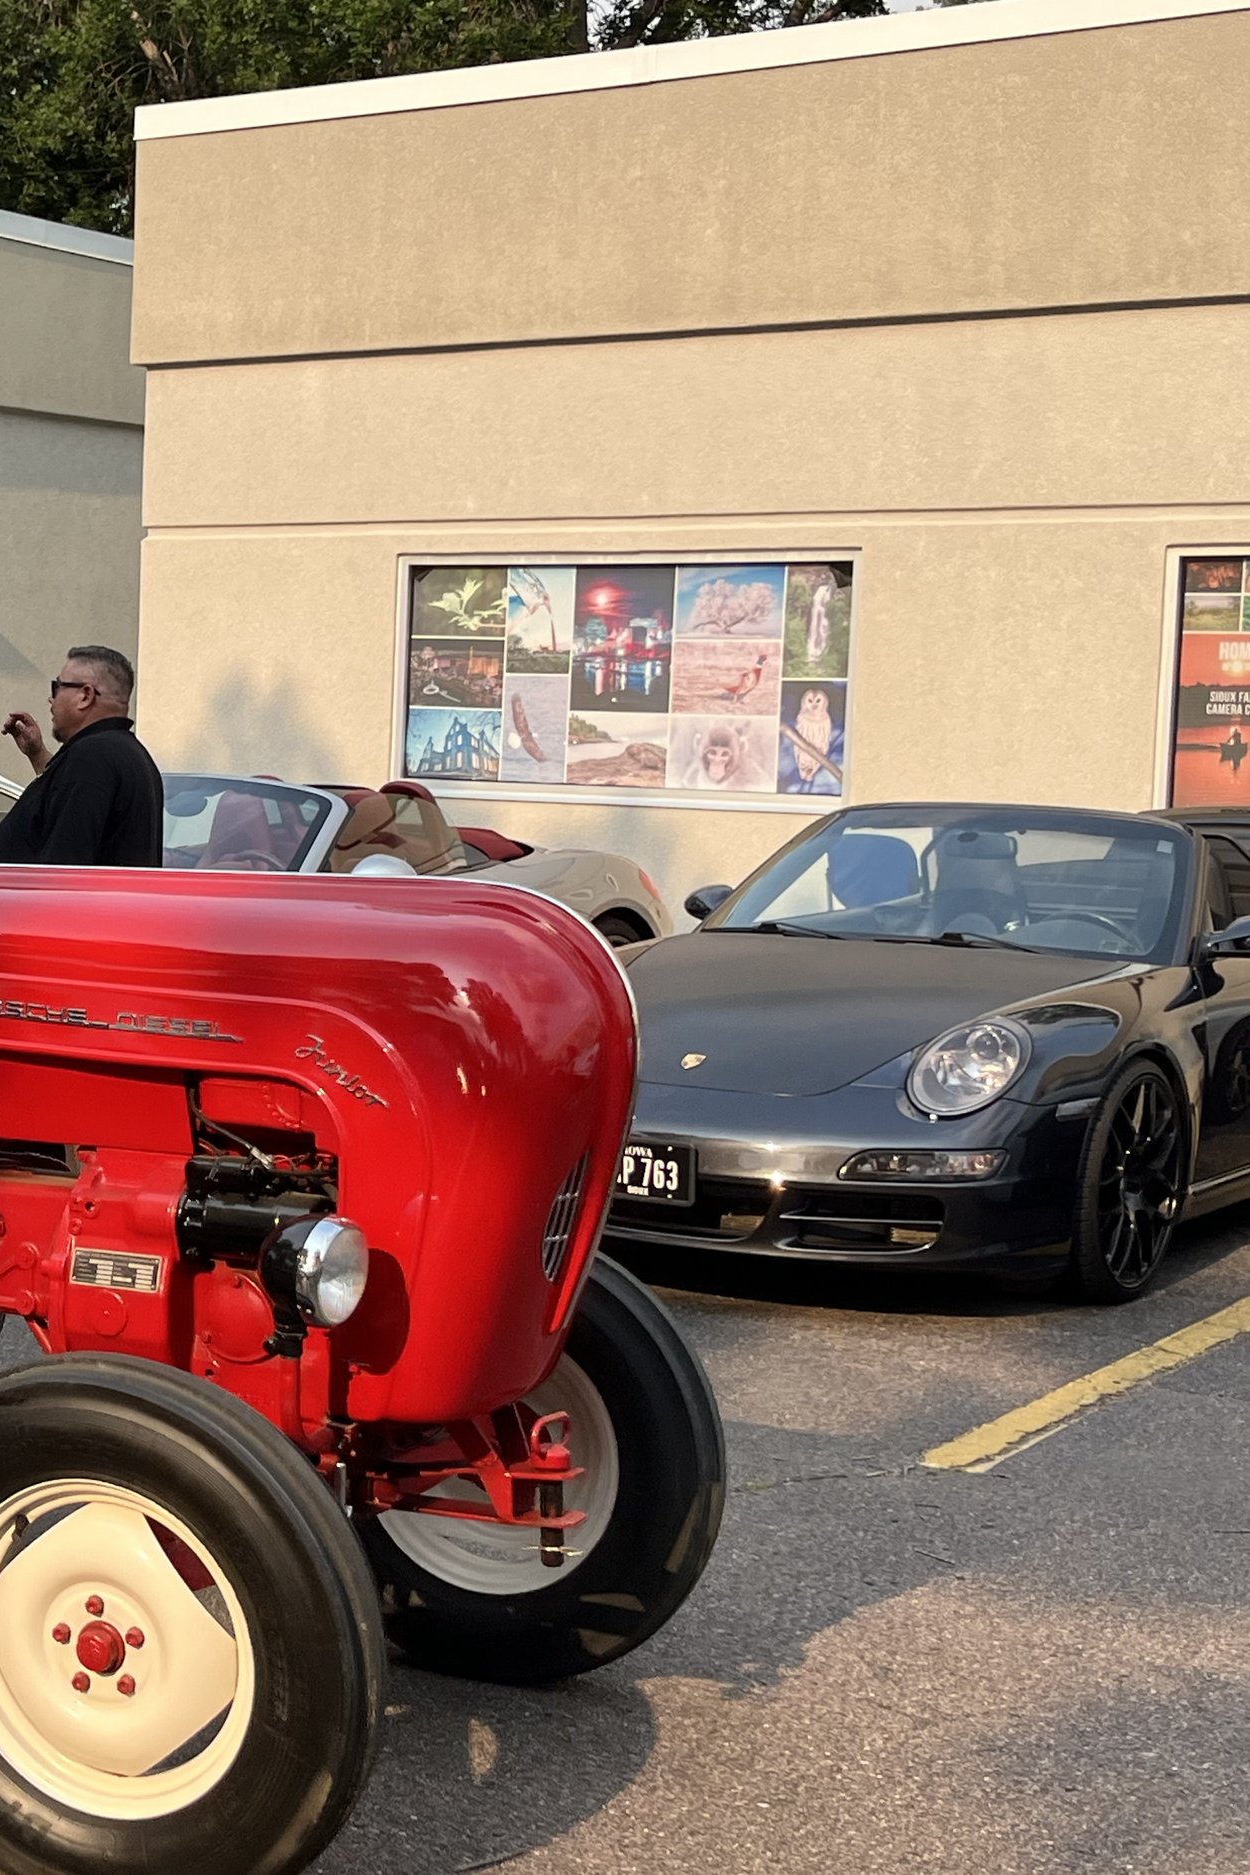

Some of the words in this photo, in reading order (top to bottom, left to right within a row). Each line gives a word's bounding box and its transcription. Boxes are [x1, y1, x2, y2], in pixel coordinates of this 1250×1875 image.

[1210, 691, 1237, 702] SIOUX
[1238, 691, 1250, 703] FA
[1206, 703, 1243, 715] CAMERA
[294, 1033, 390, 1109] Junior
[624, 1145, 653, 1158] IOWA
[640, 1157, 679, 1191] 763
